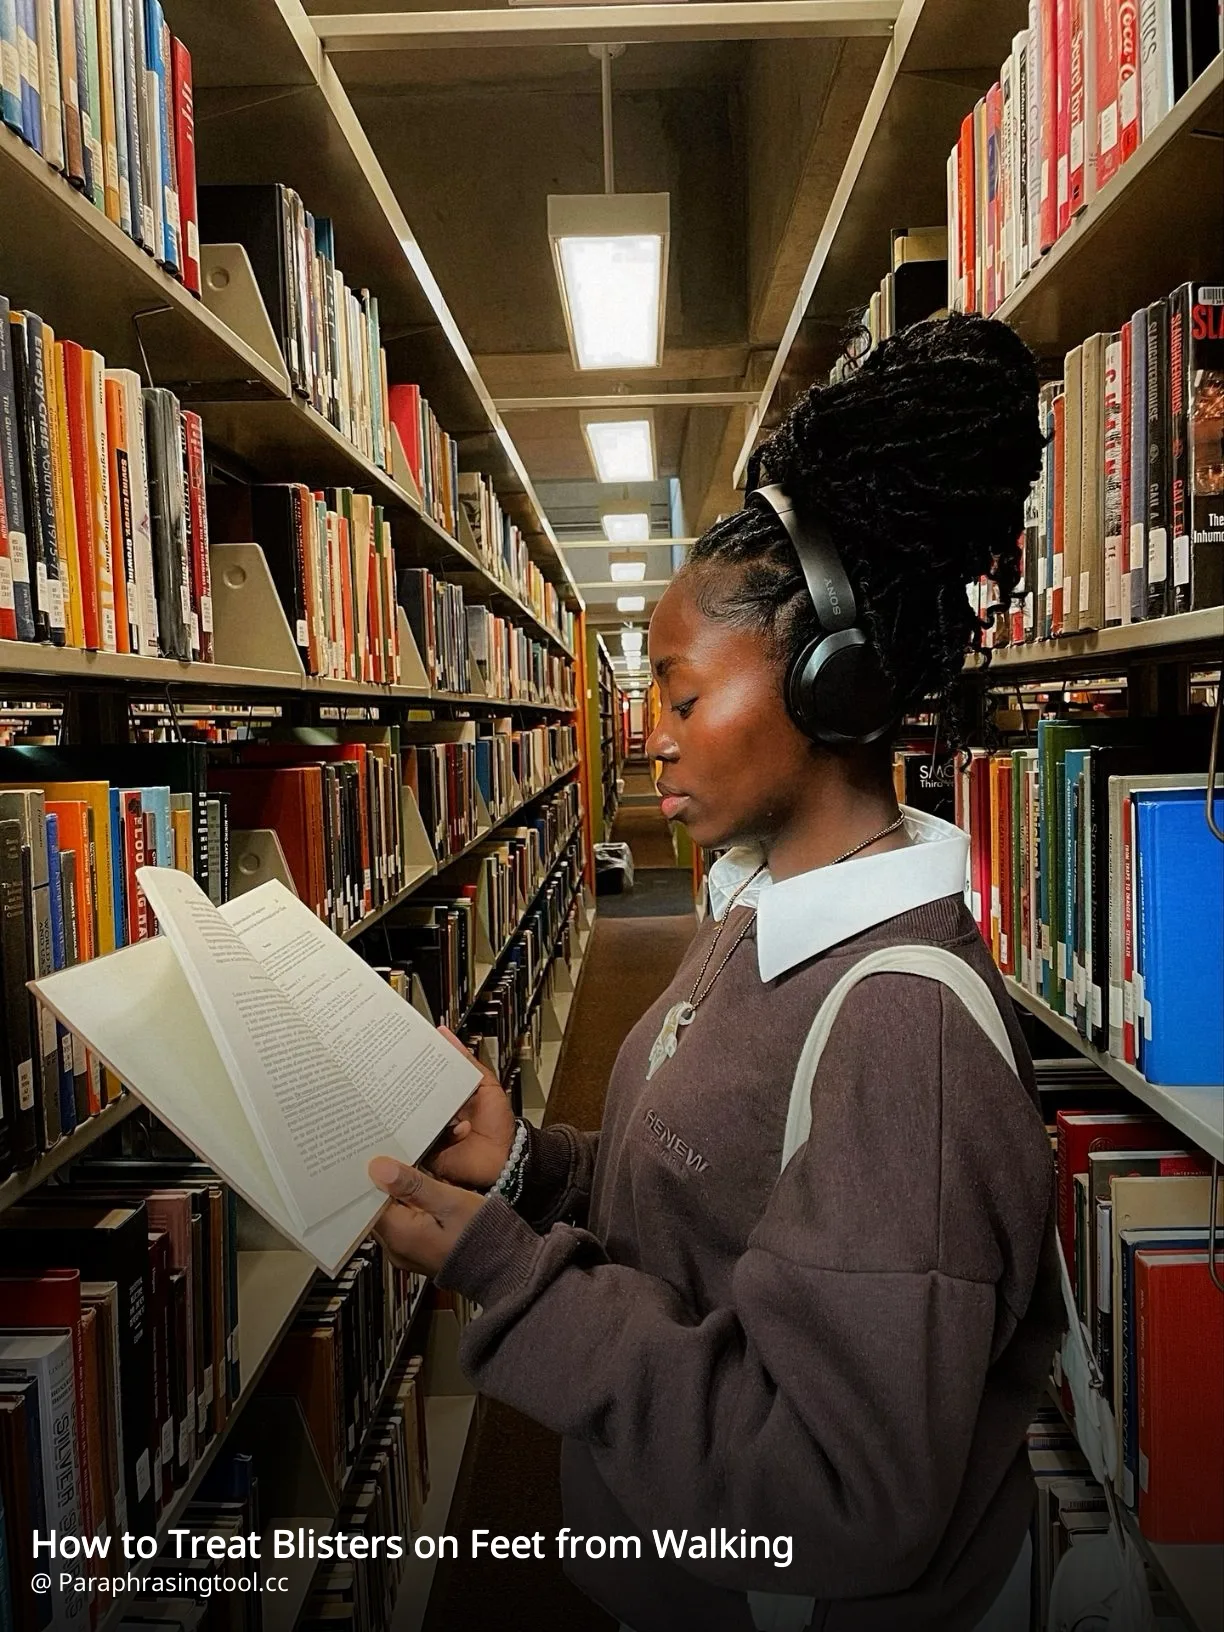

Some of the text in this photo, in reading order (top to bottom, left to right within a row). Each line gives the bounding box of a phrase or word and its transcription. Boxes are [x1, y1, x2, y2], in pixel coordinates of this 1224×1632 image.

[1071, 30, 1083, 90] Secret
[33, 335, 46, 402] Energy
[1147, 321, 1159, 424] SLAUGHTERHOUSE
[1170, 312, 1183, 417] SLAUGHTERHOUSE
[38, 401, 51, 451] Crisis
[5, 416, 16, 477] Governance
[12, 492, 20, 527] Energy
[120, 458, 129, 496] Saving
[1149, 482, 1160, 507] GAIL
[1173, 479, 1184, 505] GAIL
[100, 431, 112, 575] Energizing Neoliberalism
[183, 471, 191, 535] ENRON
[1208, 513, 1224, 527] The
[47, 523, 59, 580] 1975-77
[824, 577, 841, 616] SONY
[53, 1412, 74, 1508] SILVER
